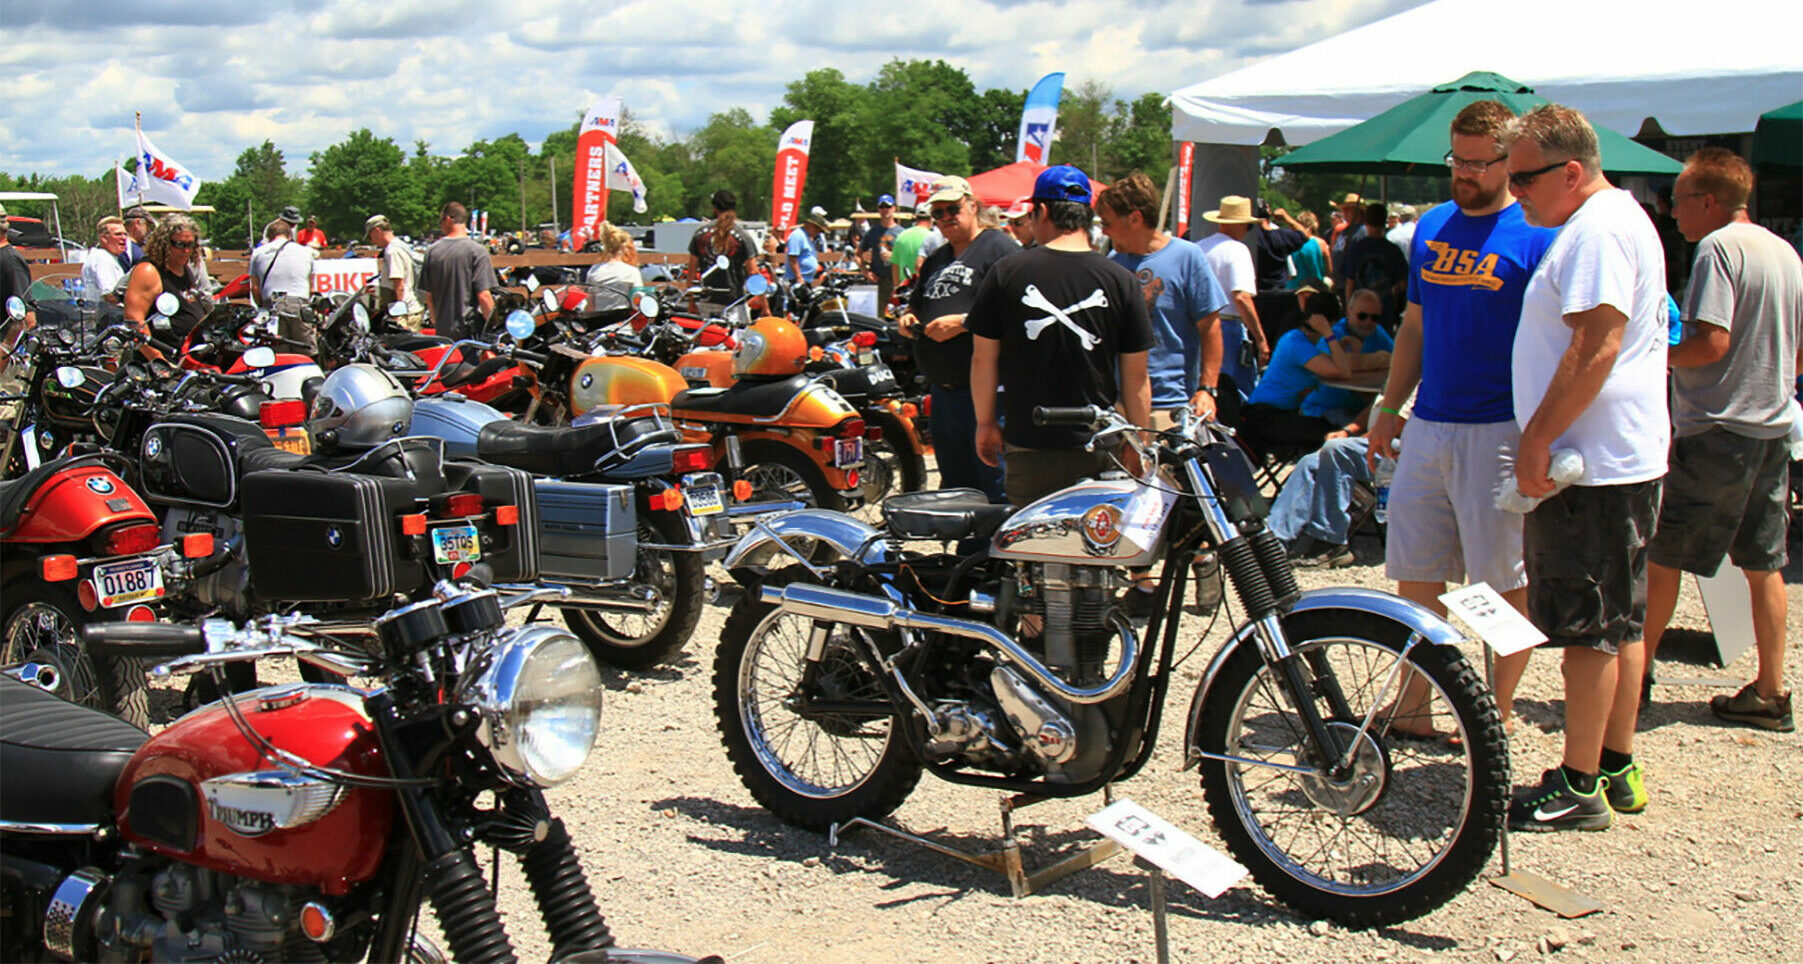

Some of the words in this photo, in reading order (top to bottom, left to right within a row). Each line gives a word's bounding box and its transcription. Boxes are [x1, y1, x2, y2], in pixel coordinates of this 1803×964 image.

[578, 146, 604, 240] PARTNERS
[783, 155, 800, 199] MEET
[1432, 247, 1500, 278] BSA
[103, 568, 155, 597] 01887
[207, 797, 277, 829] TRIUMPH
